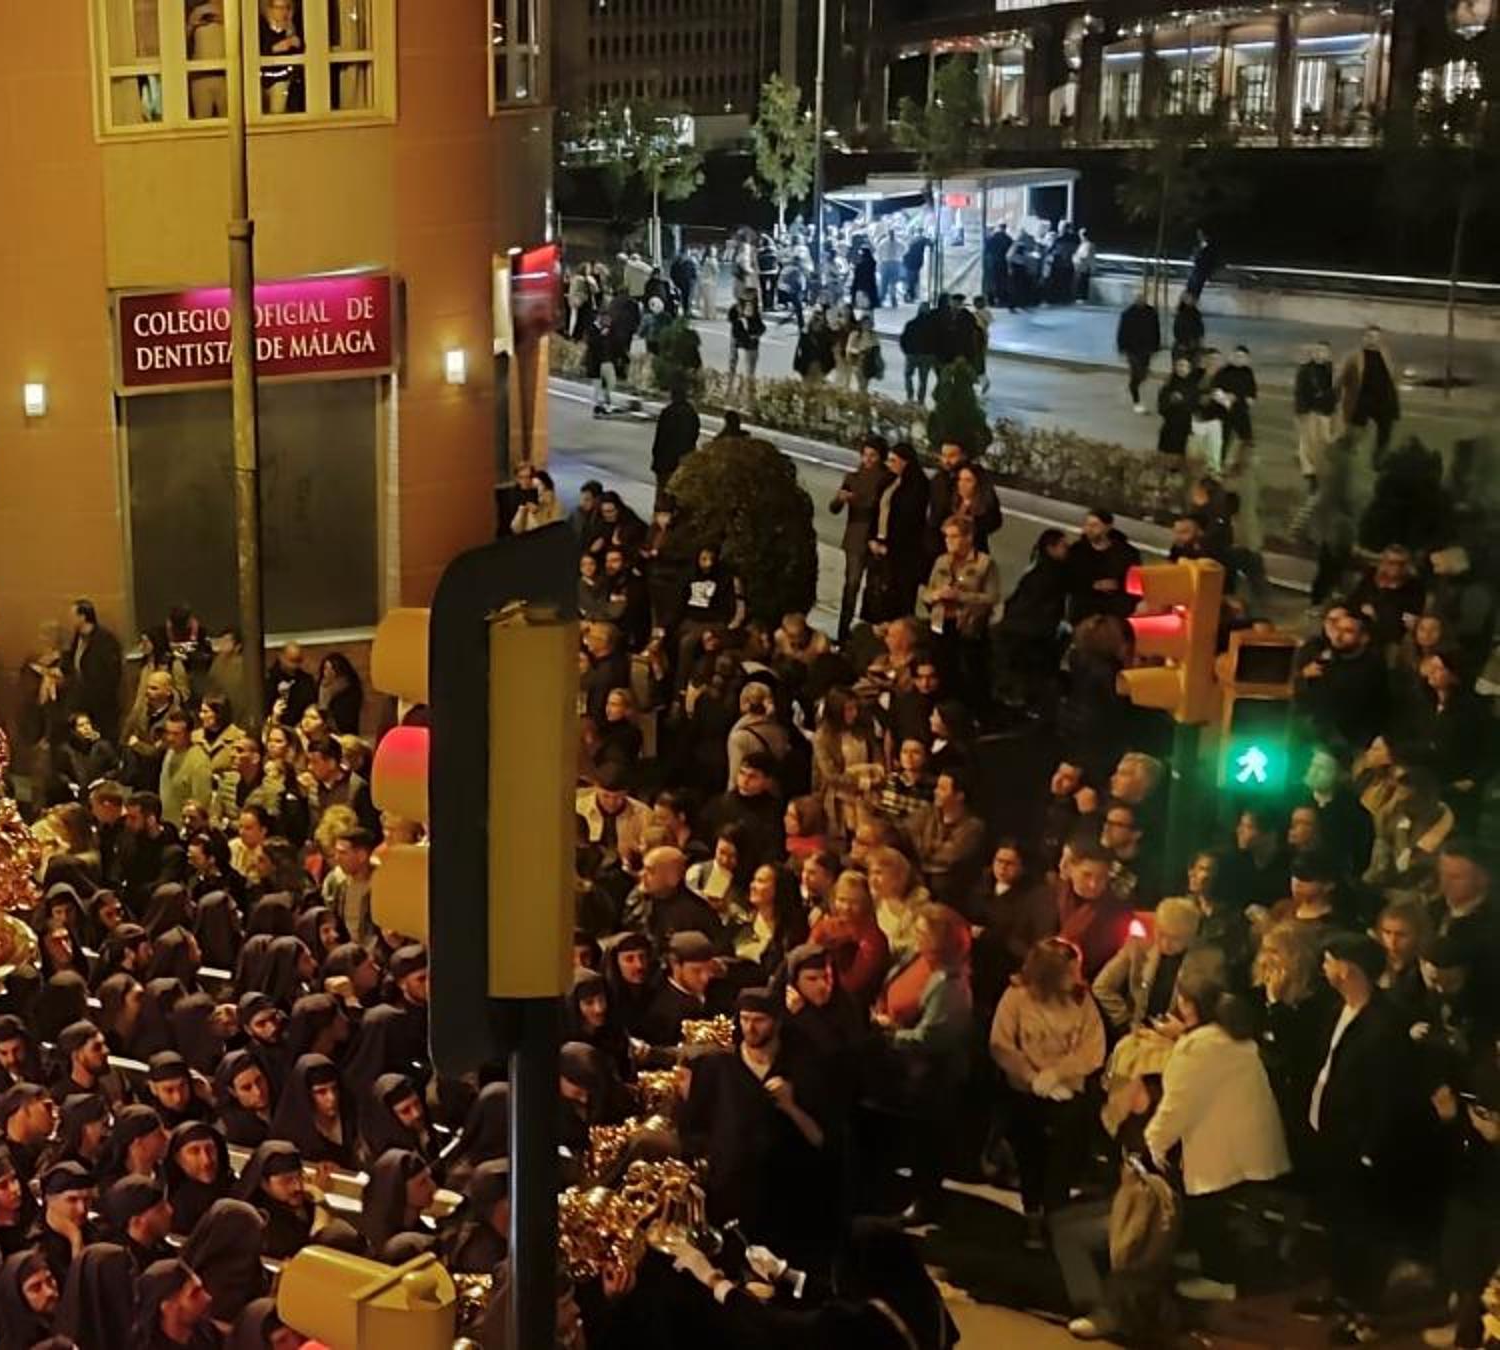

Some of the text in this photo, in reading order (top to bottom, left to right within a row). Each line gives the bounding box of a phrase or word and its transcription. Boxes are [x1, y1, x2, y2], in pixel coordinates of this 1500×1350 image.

[133, 308, 232, 337] COLEGIO
[347, 296, 374, 320] DE
[255, 337, 284, 361] DE
[288, 328, 376, 359] MÁLAGA
